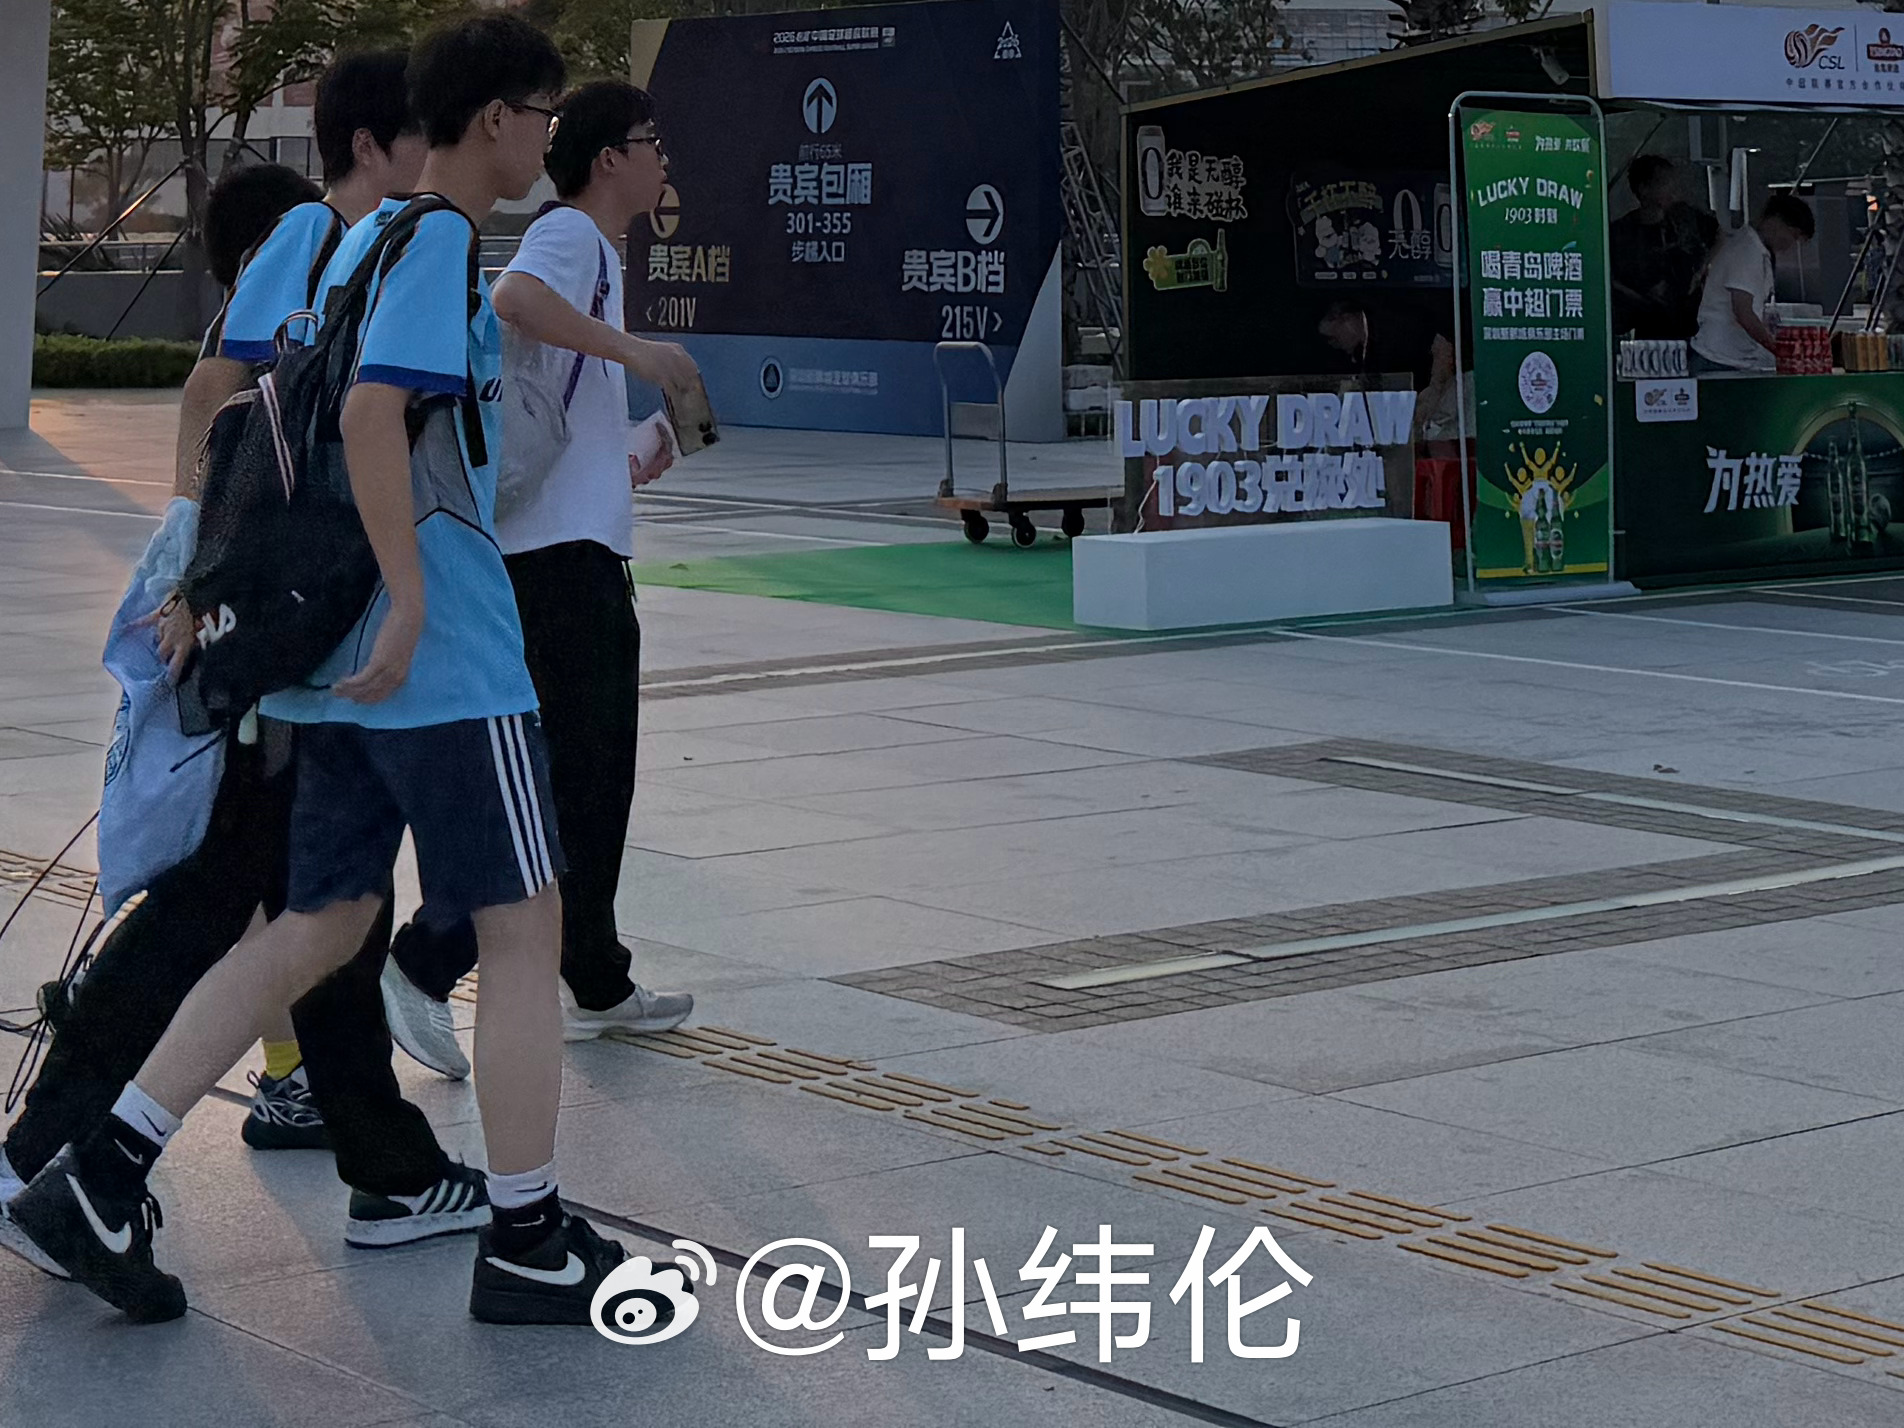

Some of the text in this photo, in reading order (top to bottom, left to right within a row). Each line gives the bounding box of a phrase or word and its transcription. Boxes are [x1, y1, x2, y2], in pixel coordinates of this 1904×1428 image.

[1818, 55, 1845, 70] CSL
[768, 162, 872, 205] 贵宾包厢
[1166, 150, 1244, 189] 我是无醇
[1477, 177, 1583, 210] LUCKY DRAW
[786, 212, 852, 234] 301-355
[647, 243, 731, 283] 贵宾A档
[901, 249, 1005, 293] 贵宾B档
[1481, 250, 1583, 281] 喝青岛啤酒
[657, 296, 697, 328] 201V
[1482, 287, 1584, 318] 赢中超门票
[941, 305, 988, 340] 215V
[1114, 390, 1418, 458] LUCKY DRAW
[1153, 450, 1386, 517] 1903兑换处
[1703, 445, 1804, 514] 为热爱
